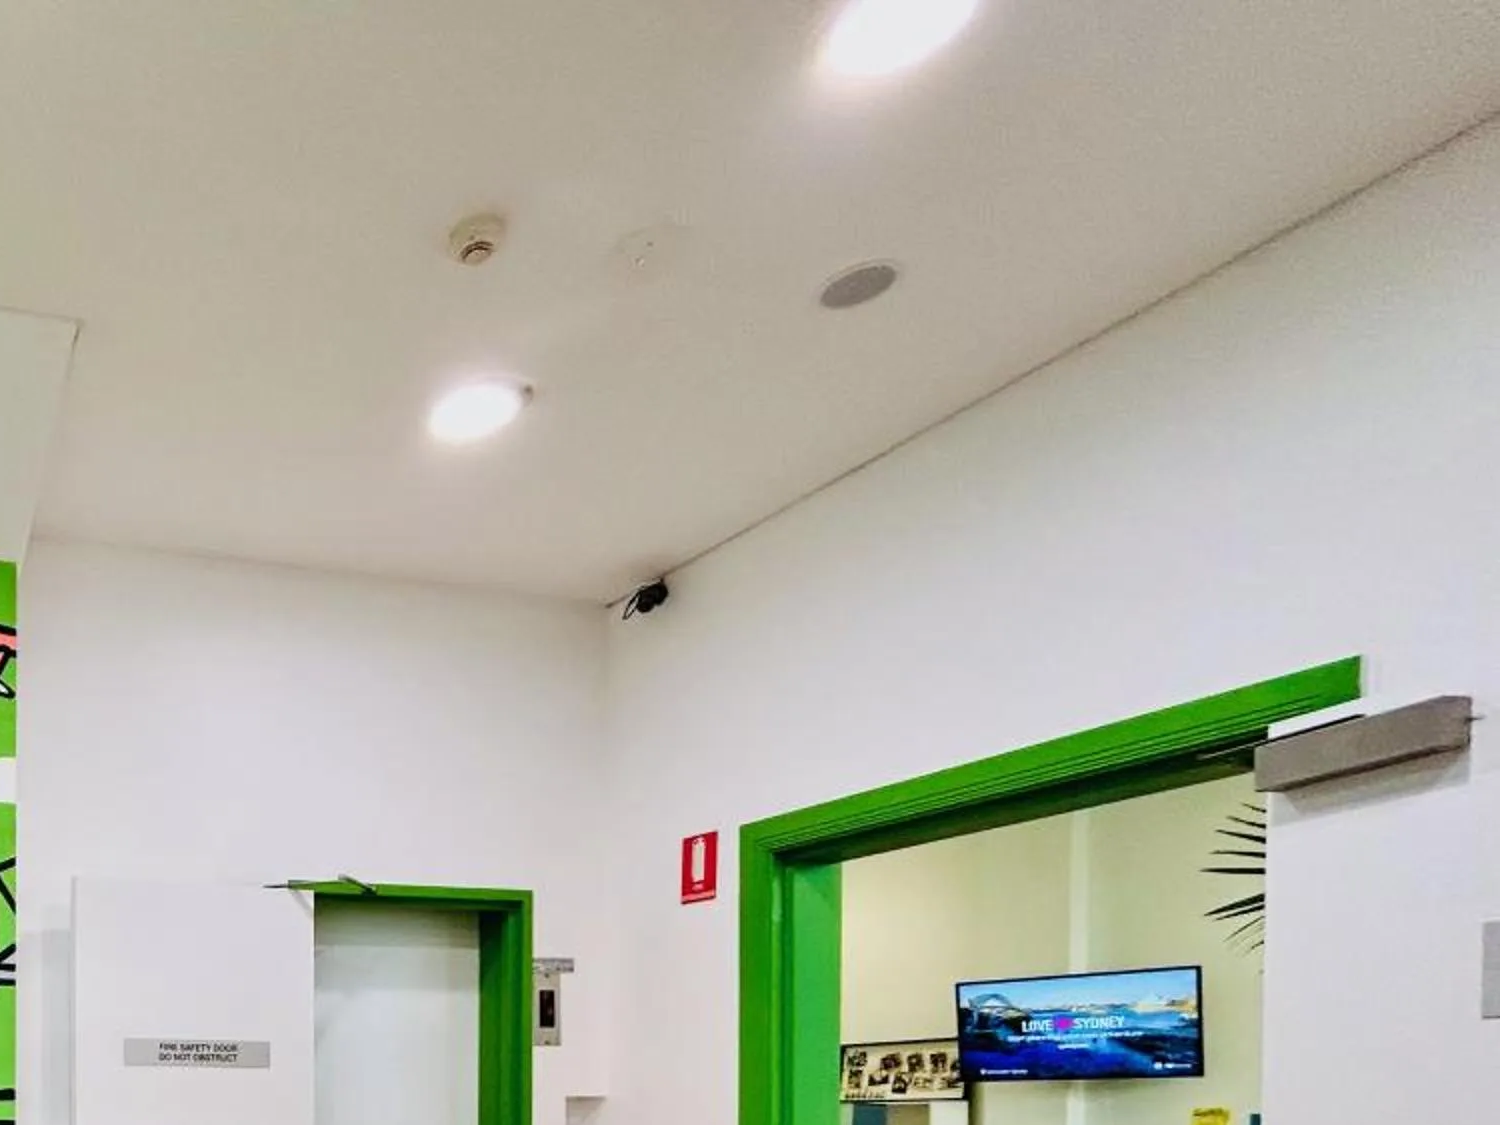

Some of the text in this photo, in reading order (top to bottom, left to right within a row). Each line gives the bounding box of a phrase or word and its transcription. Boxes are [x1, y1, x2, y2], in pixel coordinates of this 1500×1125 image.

[1021, 1016, 1125, 1033] LOVE SYDNEY
[179, 1043, 211, 1052] SAFETY
[213, 1044, 238, 1053] DOOR
[158, 1054, 238, 1063] DO NOT OBSTRUCT
